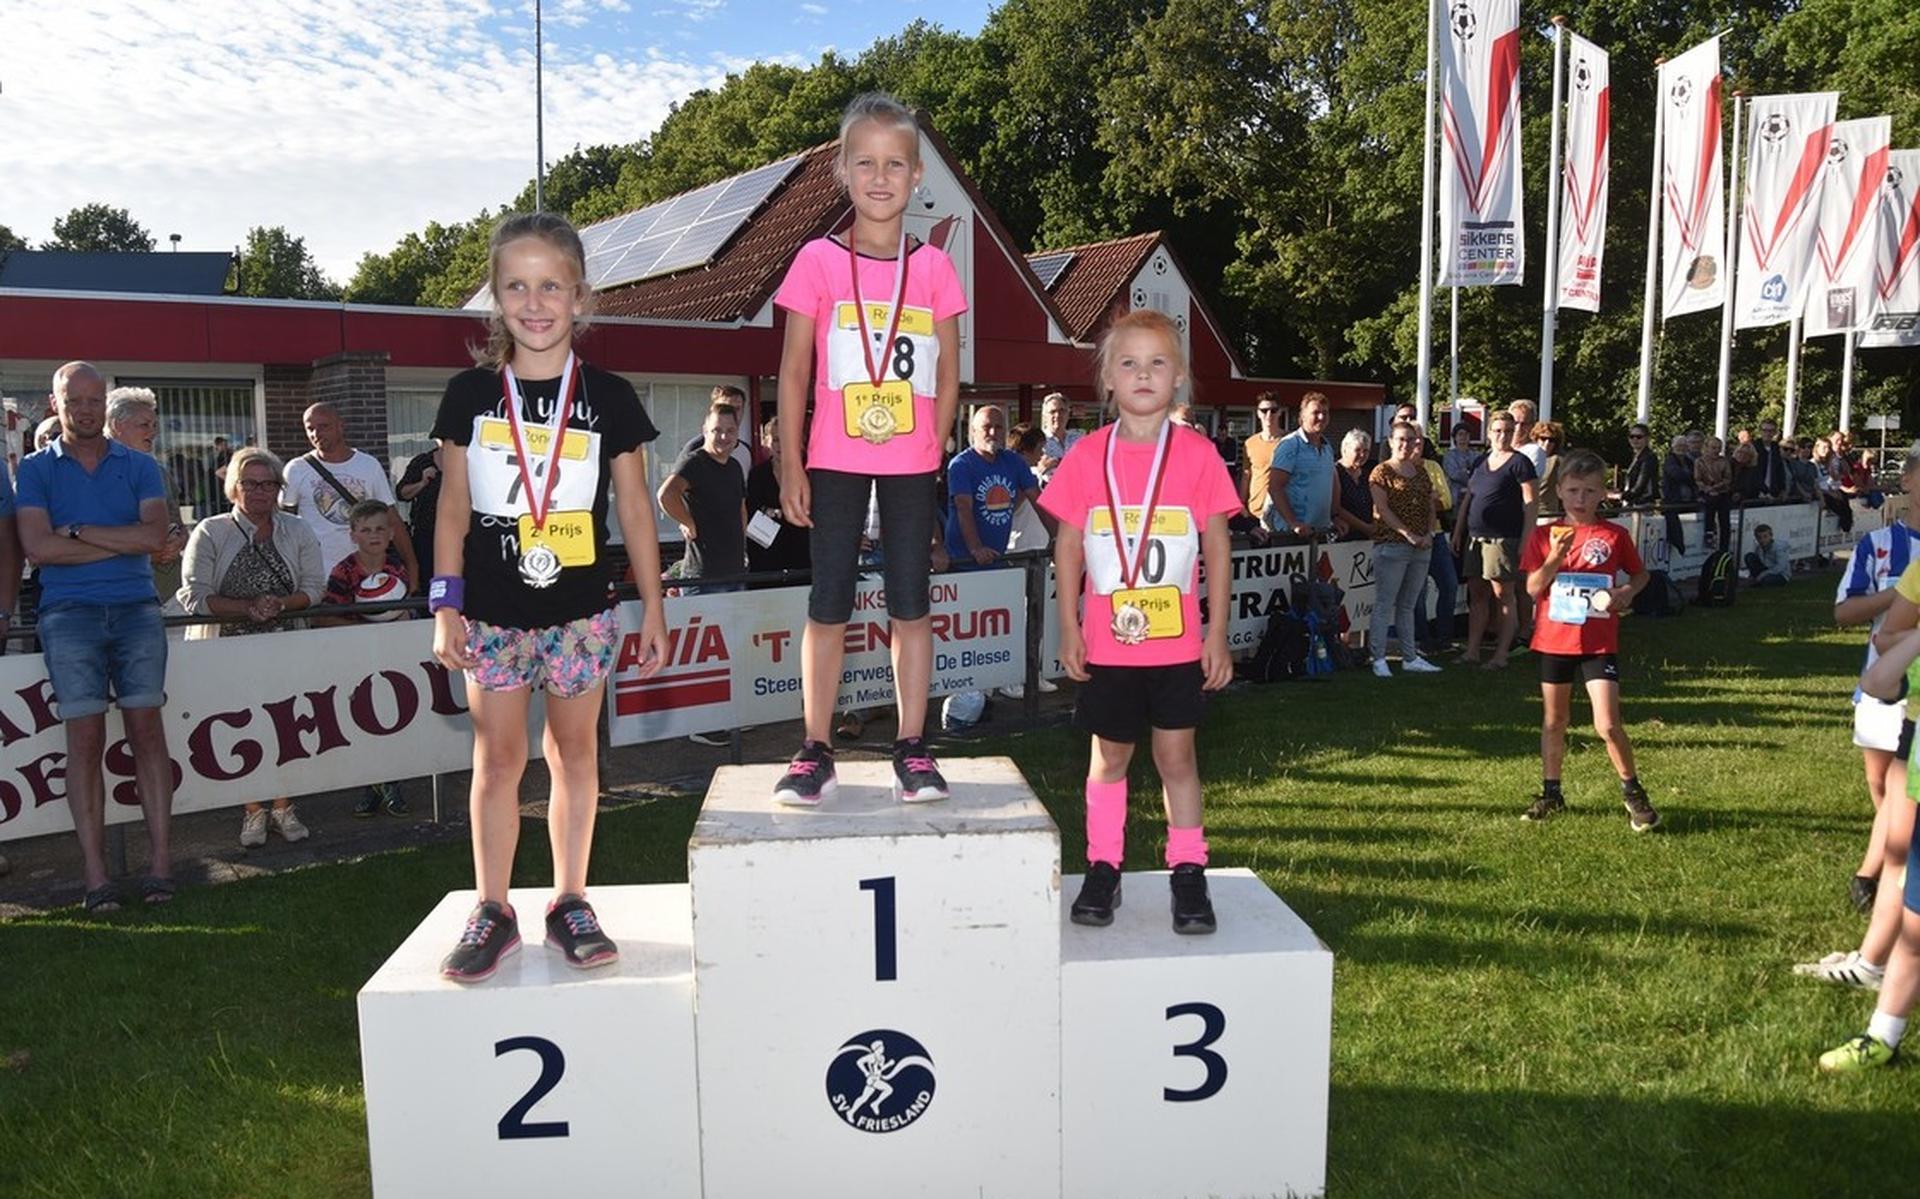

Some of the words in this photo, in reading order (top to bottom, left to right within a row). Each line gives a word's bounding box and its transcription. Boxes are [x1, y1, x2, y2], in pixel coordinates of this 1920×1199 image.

[1459, 231, 1514, 246] sikkens
[1458, 247, 1514, 260] CENTER
[871, 392, 903, 407] Prijs
[549, 525, 582, 538] Prijs
[1140, 598, 1171, 612] Prijs
[936, 654, 957, 671] De
[961, 650, 1010, 668] Blesse
[856, 687, 893, 703] Mieke
[942, 676, 974, 690] Voort
[859, 876, 897, 982] 1
[1163, 1002, 1228, 1103] 3
[494, 1036, 570, 1140] 2
[832, 1093, 850, 1113] SV
[856, 1090, 931, 1131] FRIESLAND
